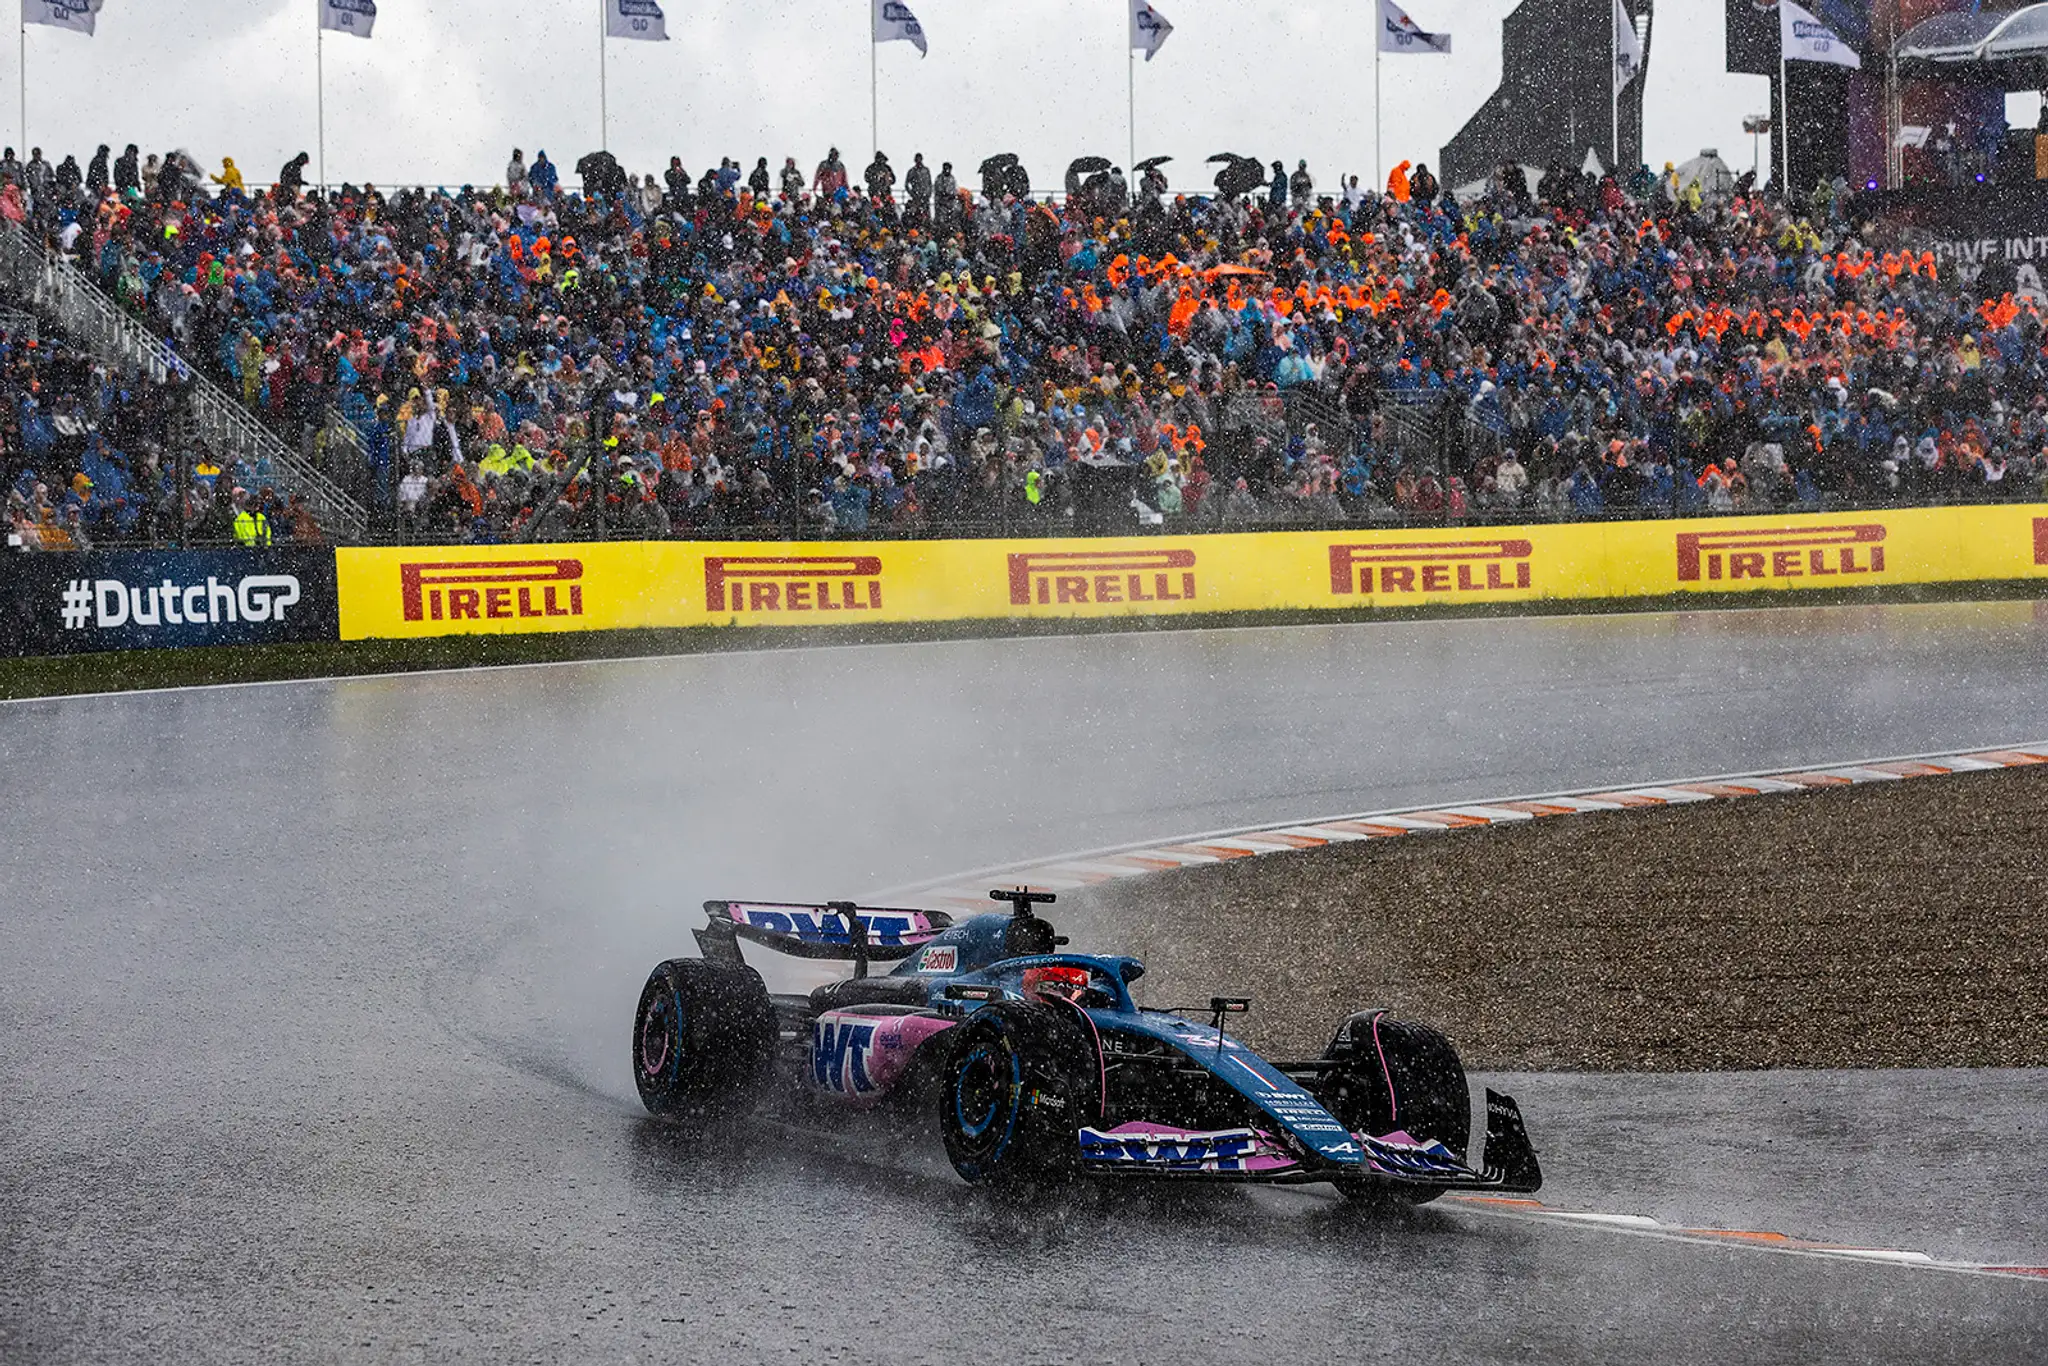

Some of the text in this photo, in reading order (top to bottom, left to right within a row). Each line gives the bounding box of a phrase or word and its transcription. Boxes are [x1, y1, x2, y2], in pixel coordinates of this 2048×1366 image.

[1008, 549, 1195, 604] PIRELLI
[1329, 540, 1533, 594] PIRELLI
[1676, 524, 1887, 581] PIRELLI
[62, 574, 301, 629] #DutchGP
[401, 559, 584, 622] PIRELLI
[704, 556, 882, 611] PIRELLI
[926, 949, 955, 970] Castrol
